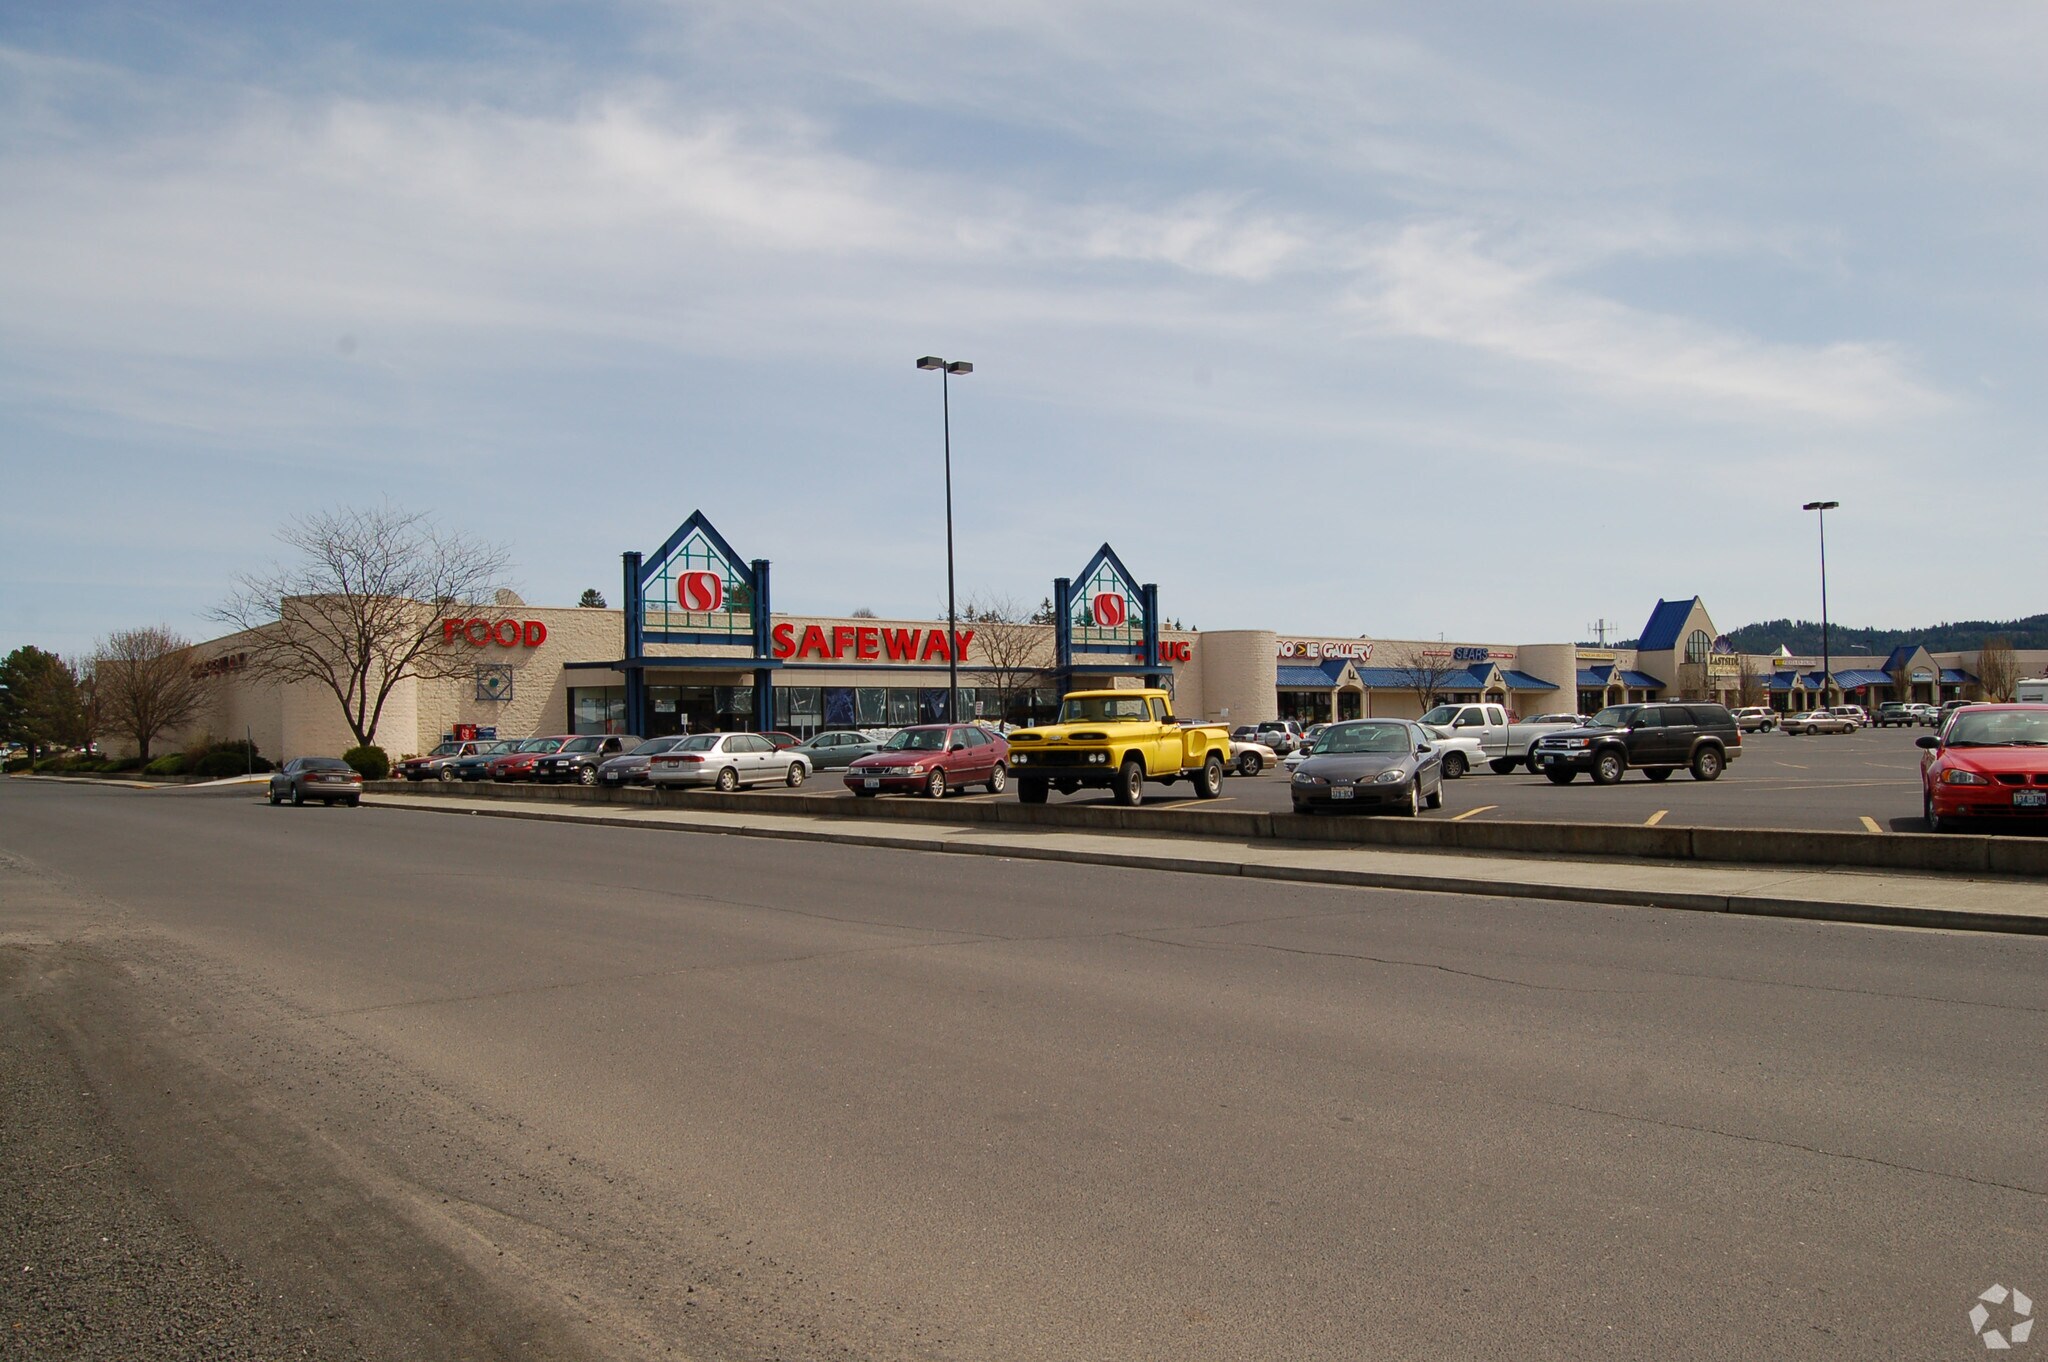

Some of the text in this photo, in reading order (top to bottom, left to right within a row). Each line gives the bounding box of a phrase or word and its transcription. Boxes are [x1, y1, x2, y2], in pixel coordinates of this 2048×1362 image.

[442, 618, 547, 647] FOOD
[772, 623, 975, 661] SAFEWAY
[1136, 641, 1191, 662] UG
[1322, 642, 1373, 662] GALLERY
[1455, 647, 1488, 660] SEARS
